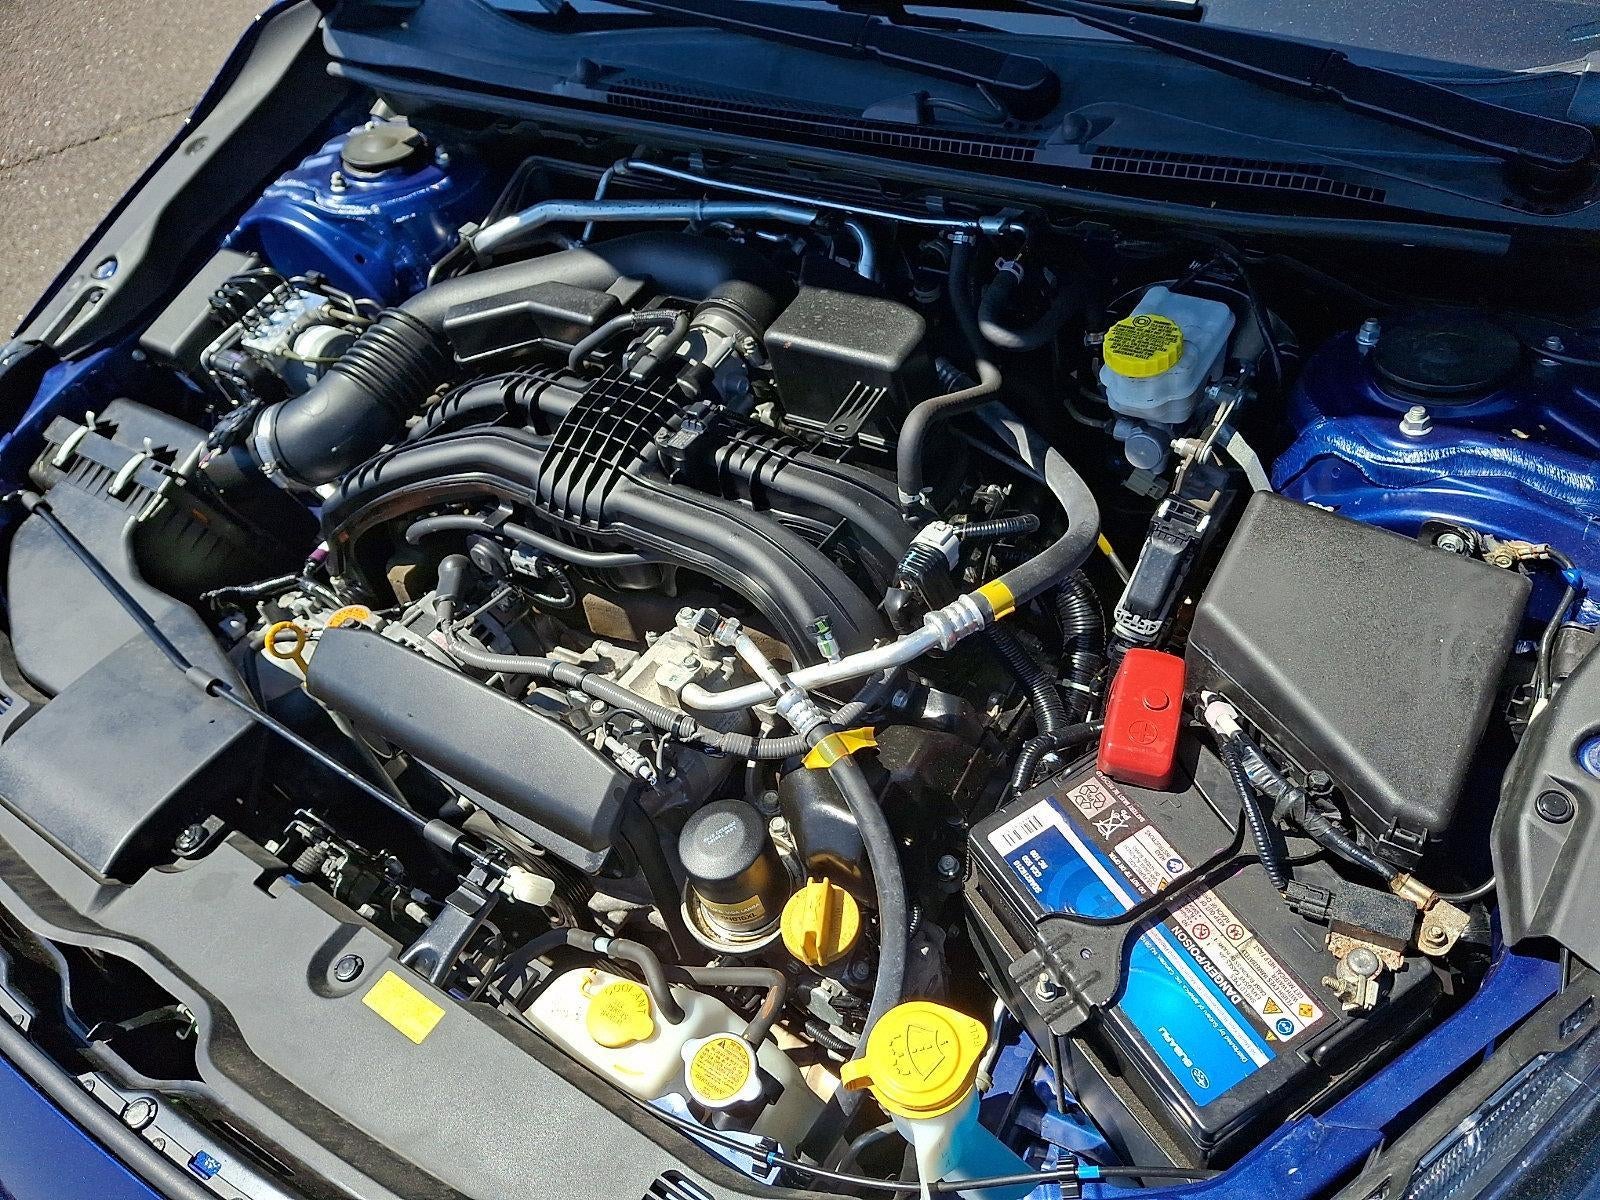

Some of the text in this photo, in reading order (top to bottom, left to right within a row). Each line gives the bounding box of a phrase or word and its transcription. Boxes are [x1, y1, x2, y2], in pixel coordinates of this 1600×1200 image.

[1117, 793, 1130, 805] MUST
[1117, 808, 1131, 820] Pb
[1126, 803, 1145, 822] BATTERY
[1028, 864, 1042, 878] CCA
[1036, 858, 1048, 870] RC
[1117, 863, 1127, 871] OR
[1123, 869, 1133, 878] TIP
[1129, 876, 1141, 887] NOT
[1137, 885, 1147, 894] DO
[1213, 914, 1226, 927] KEEP
[1215, 907, 1231, 923] REACH
[1170, 924, 1242, 1005] DANGER/POISON
[1252, 943, 1304, 999] GET MEDICAL HELP FAST
[1265, 977, 1280, 991] EYES
[1270, 972, 1299, 1002] WITH WATER
[1201, 1009, 1219, 1028] Subaru
[1156, 1025, 1194, 1068] SUBARU
[1223, 1034, 1248, 1063] Distributed
